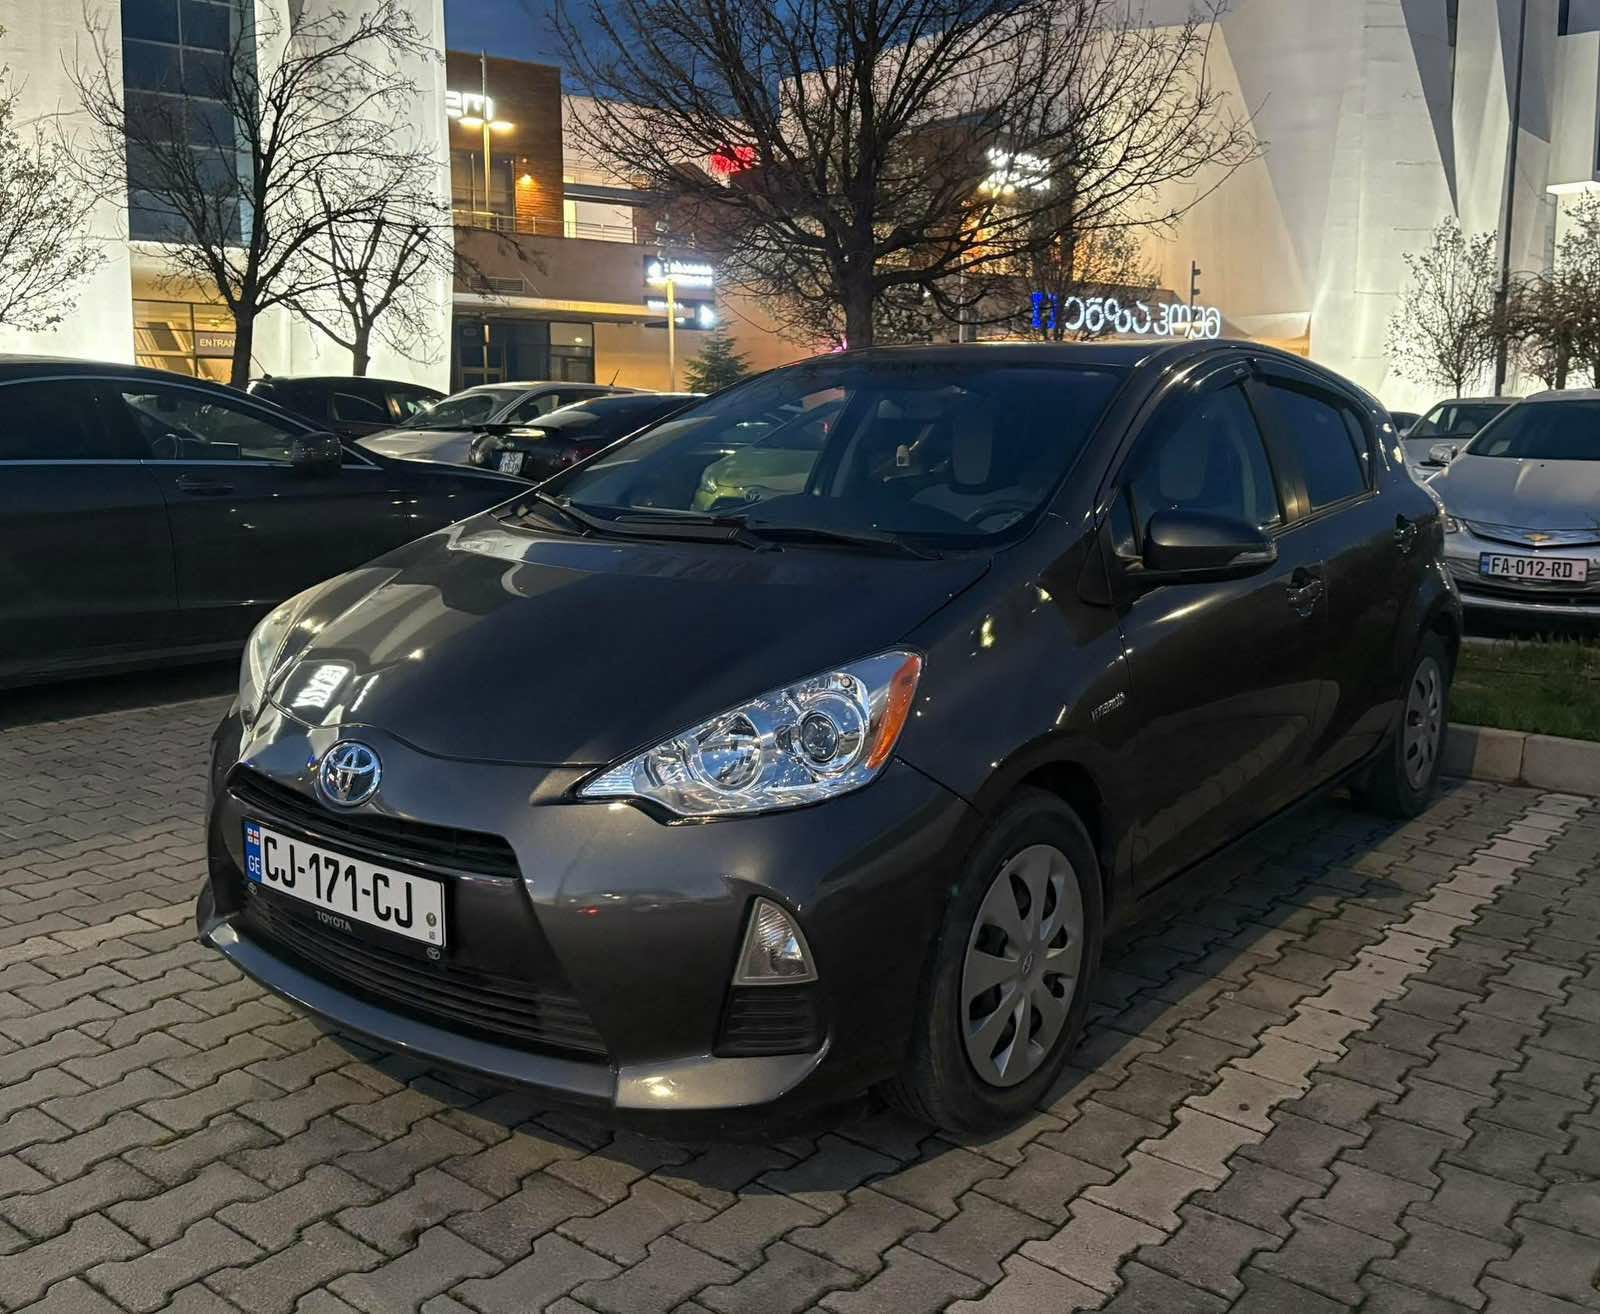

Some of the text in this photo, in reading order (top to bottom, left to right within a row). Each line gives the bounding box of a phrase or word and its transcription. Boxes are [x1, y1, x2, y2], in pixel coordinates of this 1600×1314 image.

[1491, 557, 1573, 578] FA-012-RD
[247, 836, 413, 929] GE CJ-171-CJ
[315, 910, 353, 932] TOYOTA
